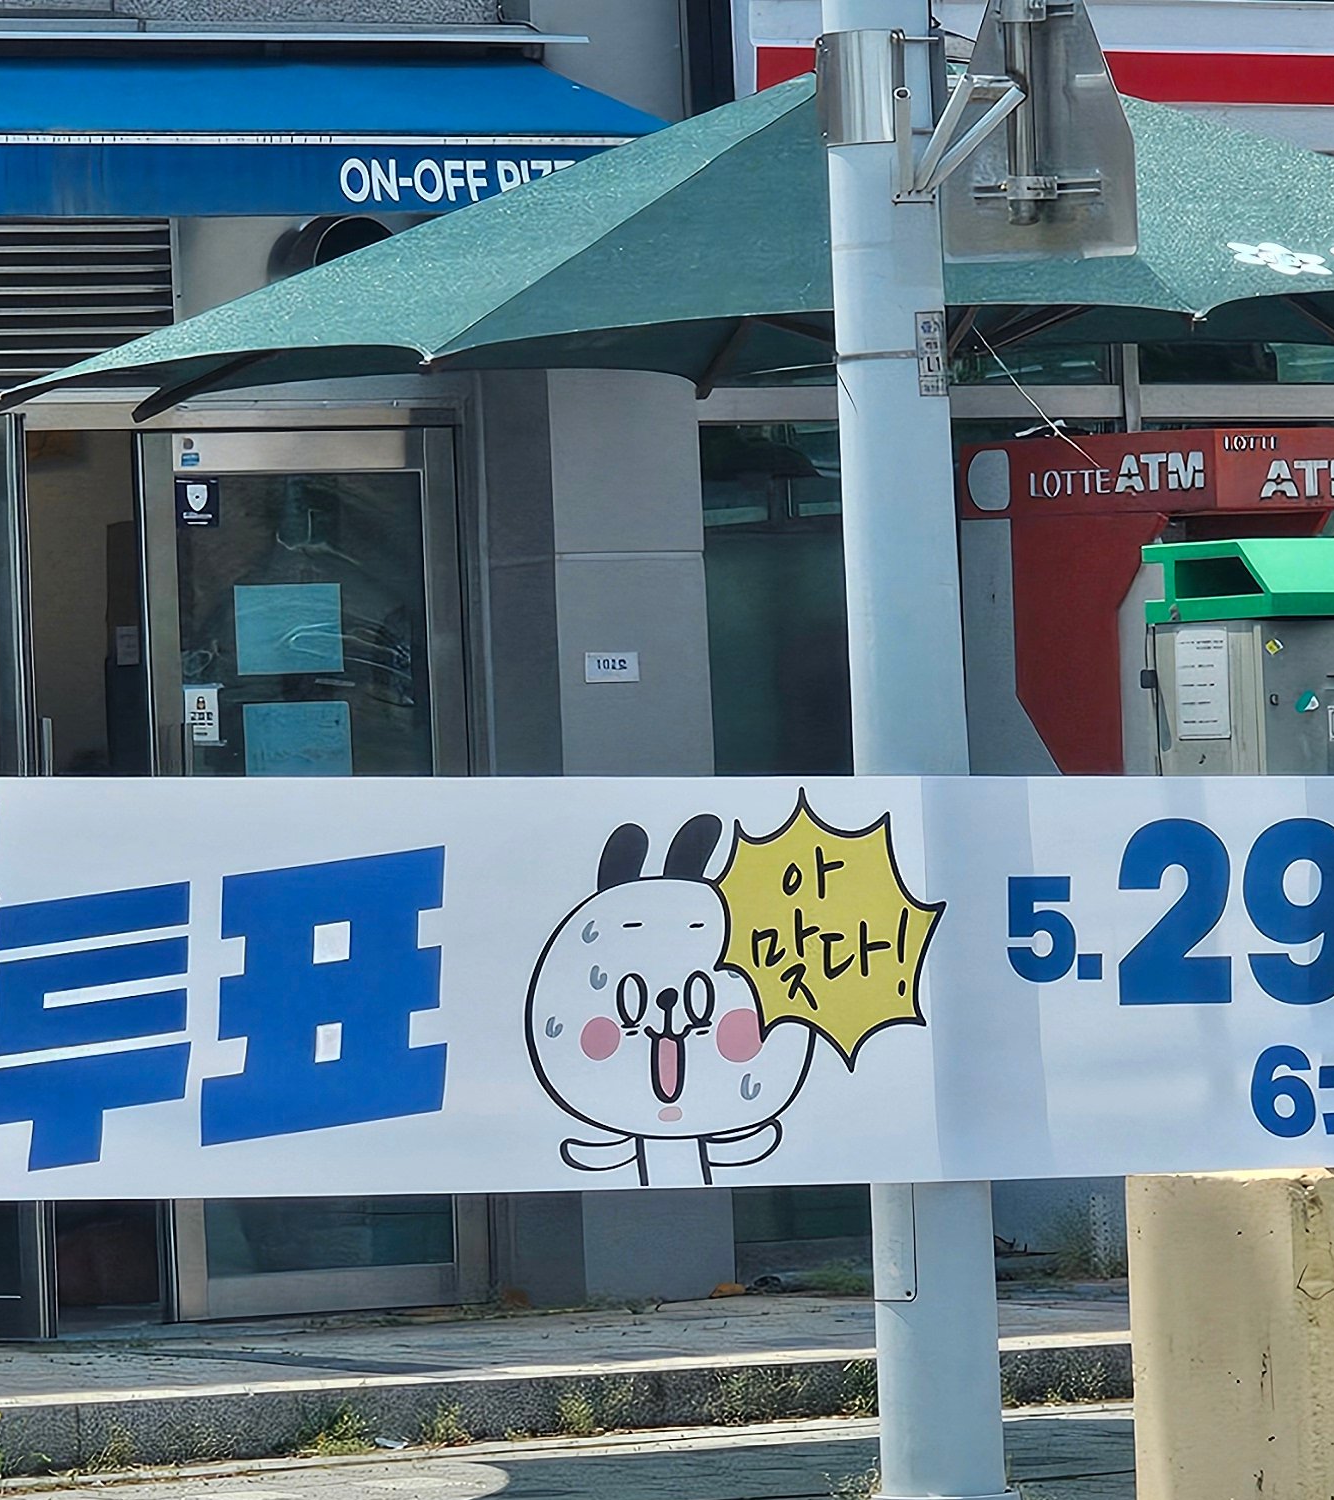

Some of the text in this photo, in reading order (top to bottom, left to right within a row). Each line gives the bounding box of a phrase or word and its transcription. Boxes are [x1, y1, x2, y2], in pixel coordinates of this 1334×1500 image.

[339, 158, 488, 202] ON-OFF
[1030, 451, 1205, 498] LOTTE ATM
[782, 845, 845, 900] 아
[751, 907, 910, 1012] 맞다!
